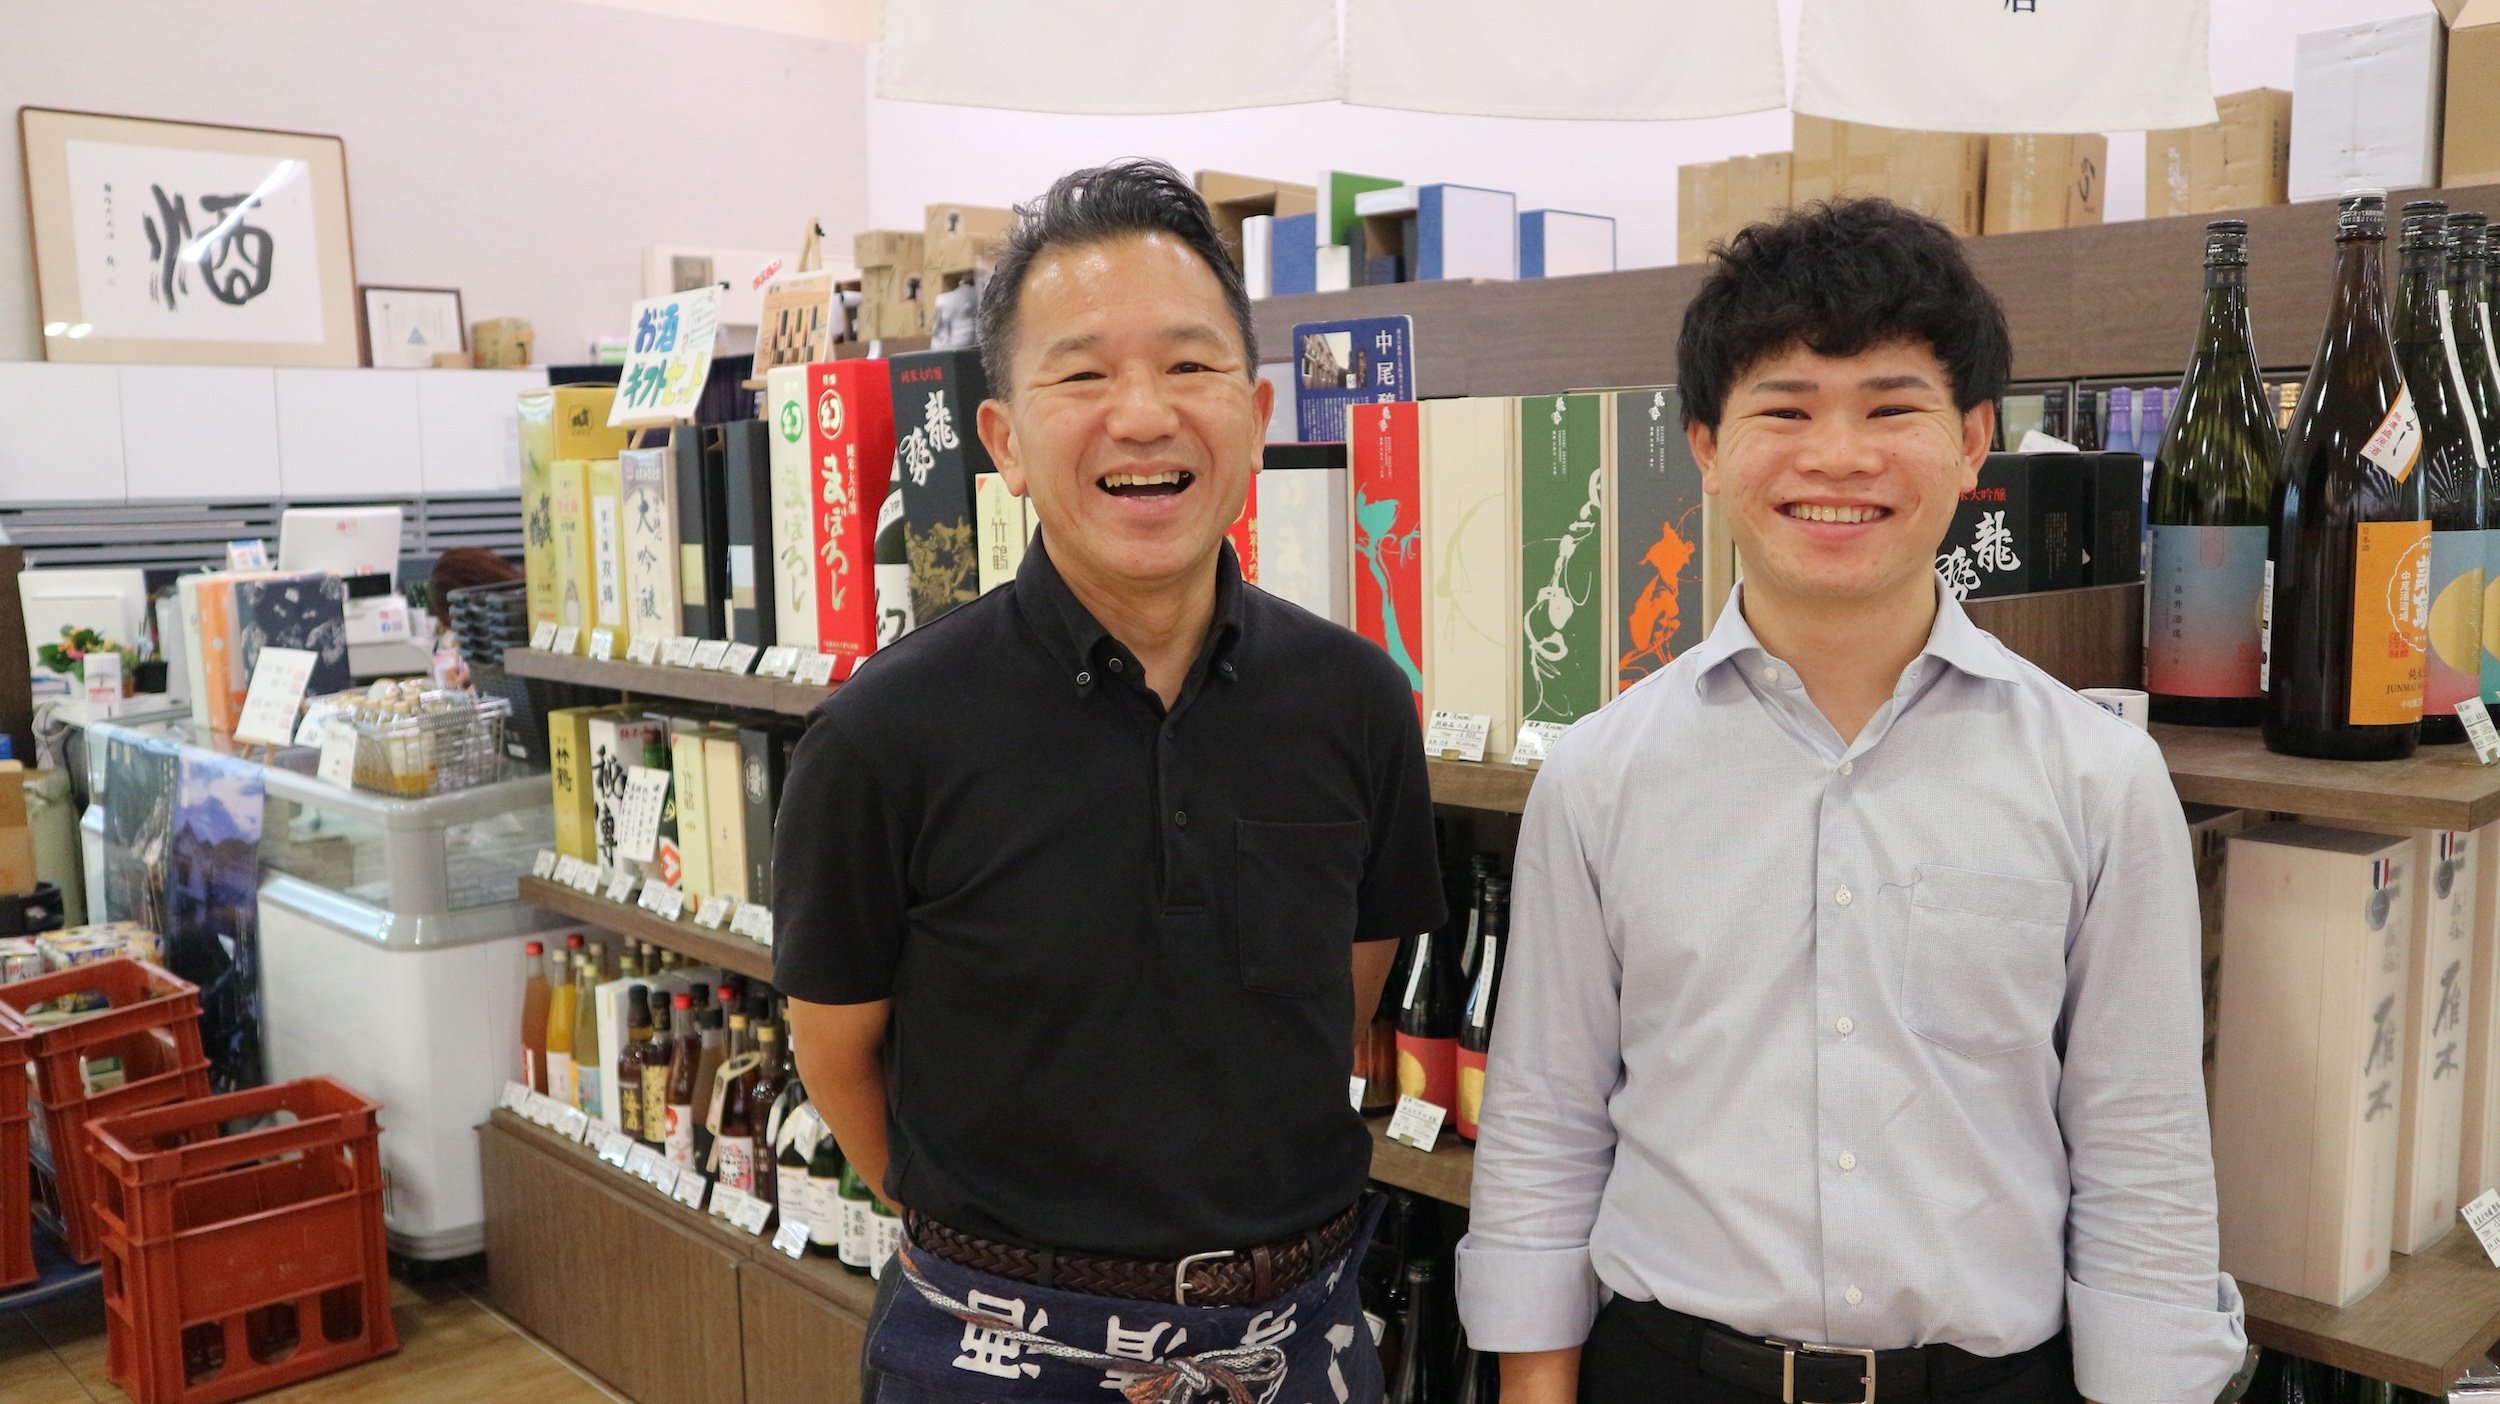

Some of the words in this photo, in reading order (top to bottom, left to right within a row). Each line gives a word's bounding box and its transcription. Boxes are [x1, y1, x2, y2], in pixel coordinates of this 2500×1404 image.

[633, 303, 679, 354] お酒
[623, 352, 703, 410] ギフトセット
[901, 366, 943, 383] 純米大吟醸
[899, 389, 959, 487] 龍勢
[846, 443, 857, 515] 純米大吟醸
[634, 488, 661, 621] 大吟醸
[819, 453, 851, 612] まぼろし
[991, 517, 1009, 570] 竹鶴
